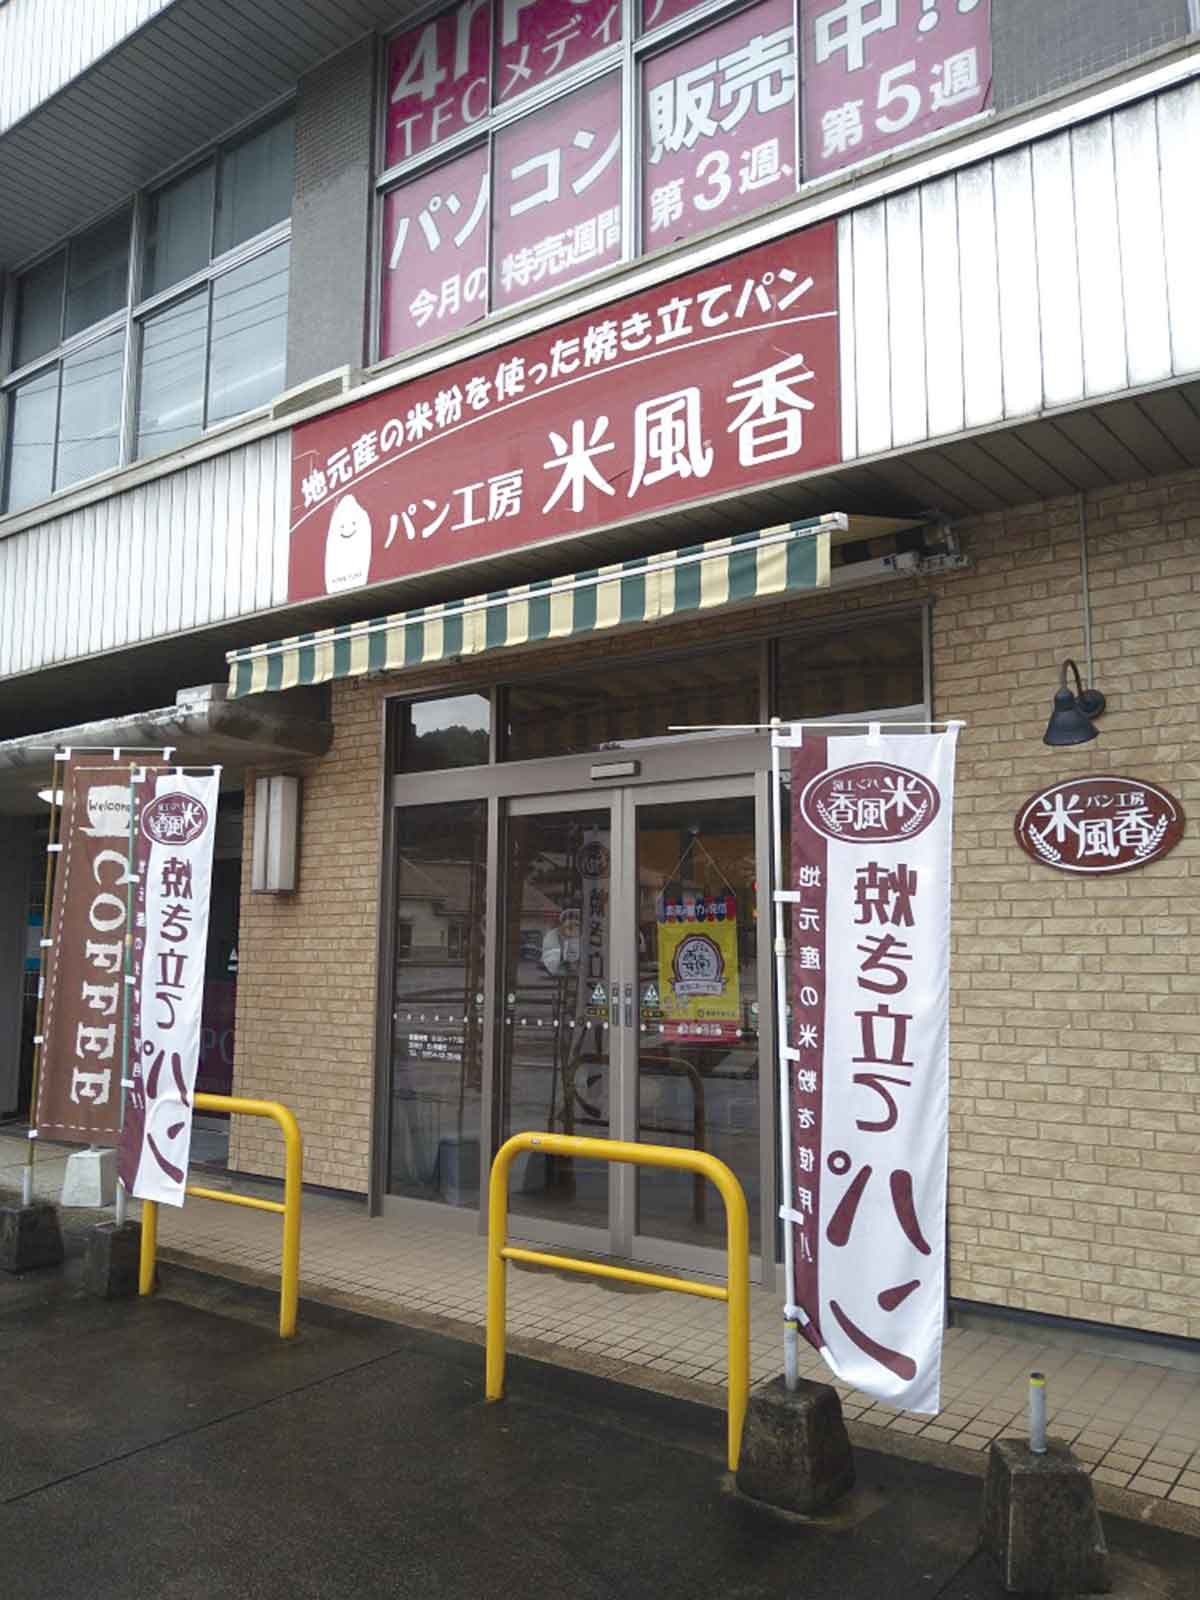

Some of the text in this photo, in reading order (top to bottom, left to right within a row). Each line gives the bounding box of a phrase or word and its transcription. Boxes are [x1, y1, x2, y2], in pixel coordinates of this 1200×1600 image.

[301, 267, 814, 507] 地元産の米粉を使った焼き立てパン
[384, 353, 815, 549] パン工房 米風香
[1036, 793, 1154, 860] 米風香
[1087, 791, 1145, 808] パン工房
[70, 849, 130, 1105] COFFEE
